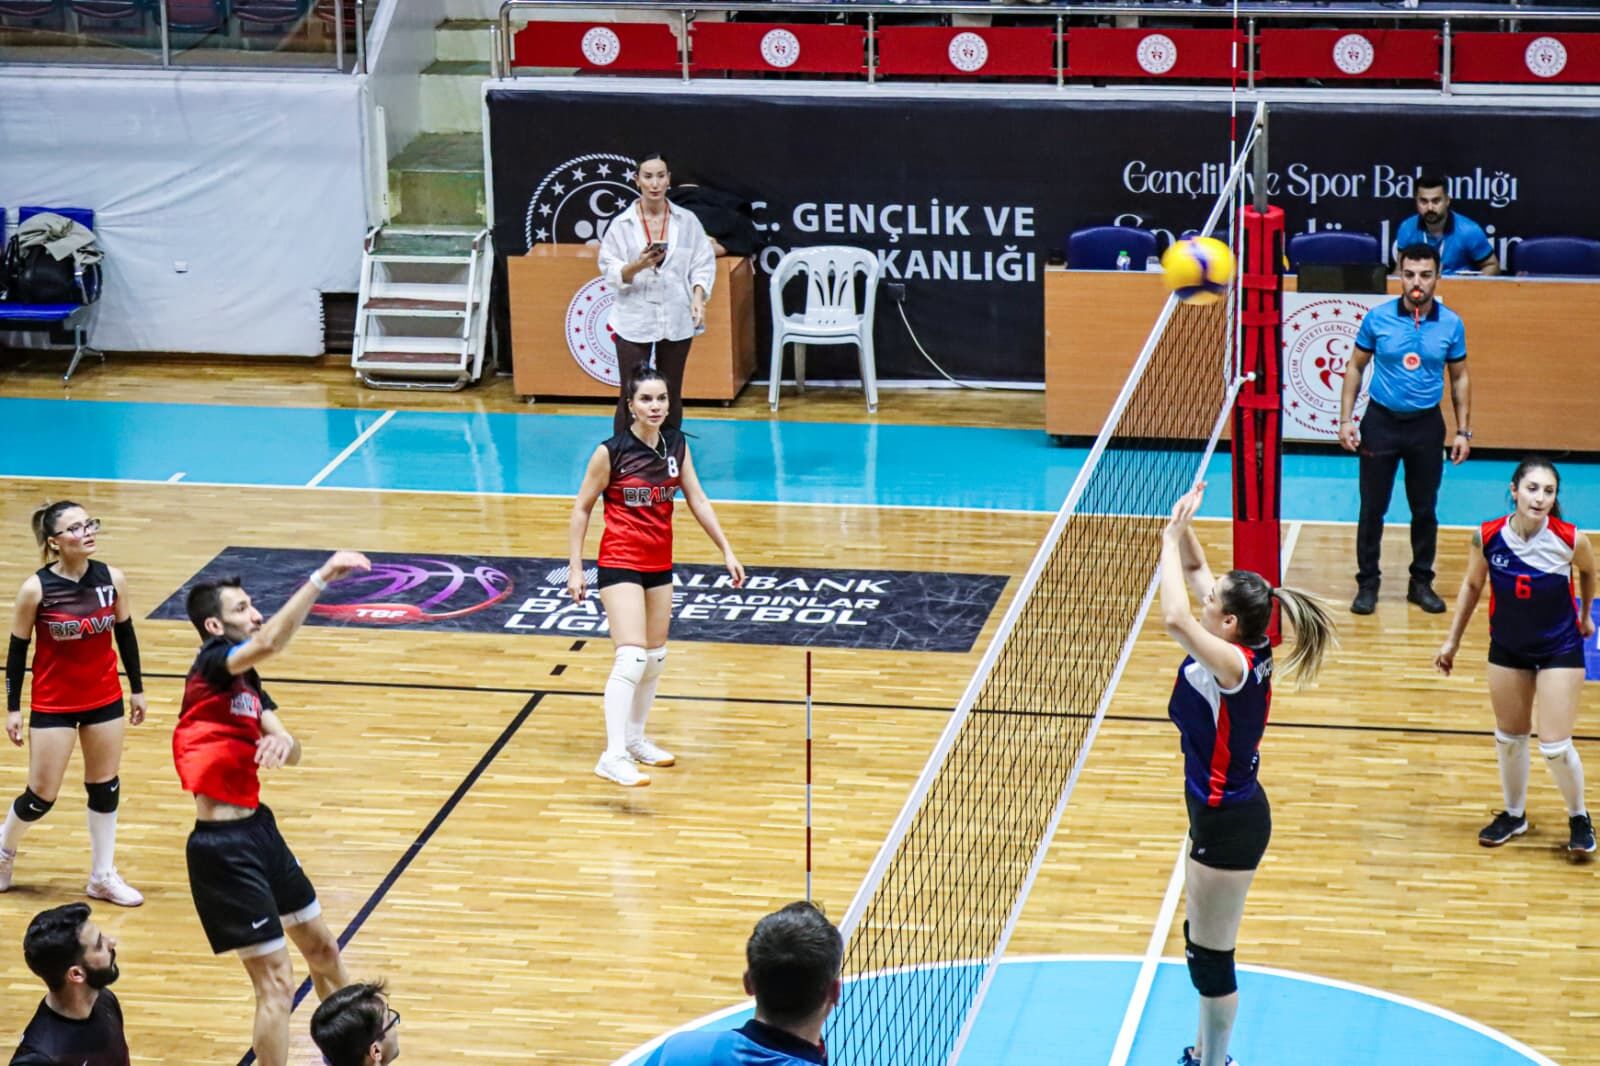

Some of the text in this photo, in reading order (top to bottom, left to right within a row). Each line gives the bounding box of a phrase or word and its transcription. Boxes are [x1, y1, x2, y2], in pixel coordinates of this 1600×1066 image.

[1288, 163, 1366, 204] Spor
[1374, 165, 1517, 208] Banlığı
[793, 198, 970, 243] GENÇLİK
[984, 206, 1035, 237] VE
[879, 244, 1036, 282] KANLIĞI
[667, 456, 679, 478] 8
[623, 485, 679, 507] BRAV
[672, 573, 891, 594] ALKBANK
[1515, 574, 1531, 599] 6
[96, 584, 114, 608] 17
[693, 593, 881, 609] KADINLAR
[518, 598, 867, 626] BAETBOL
